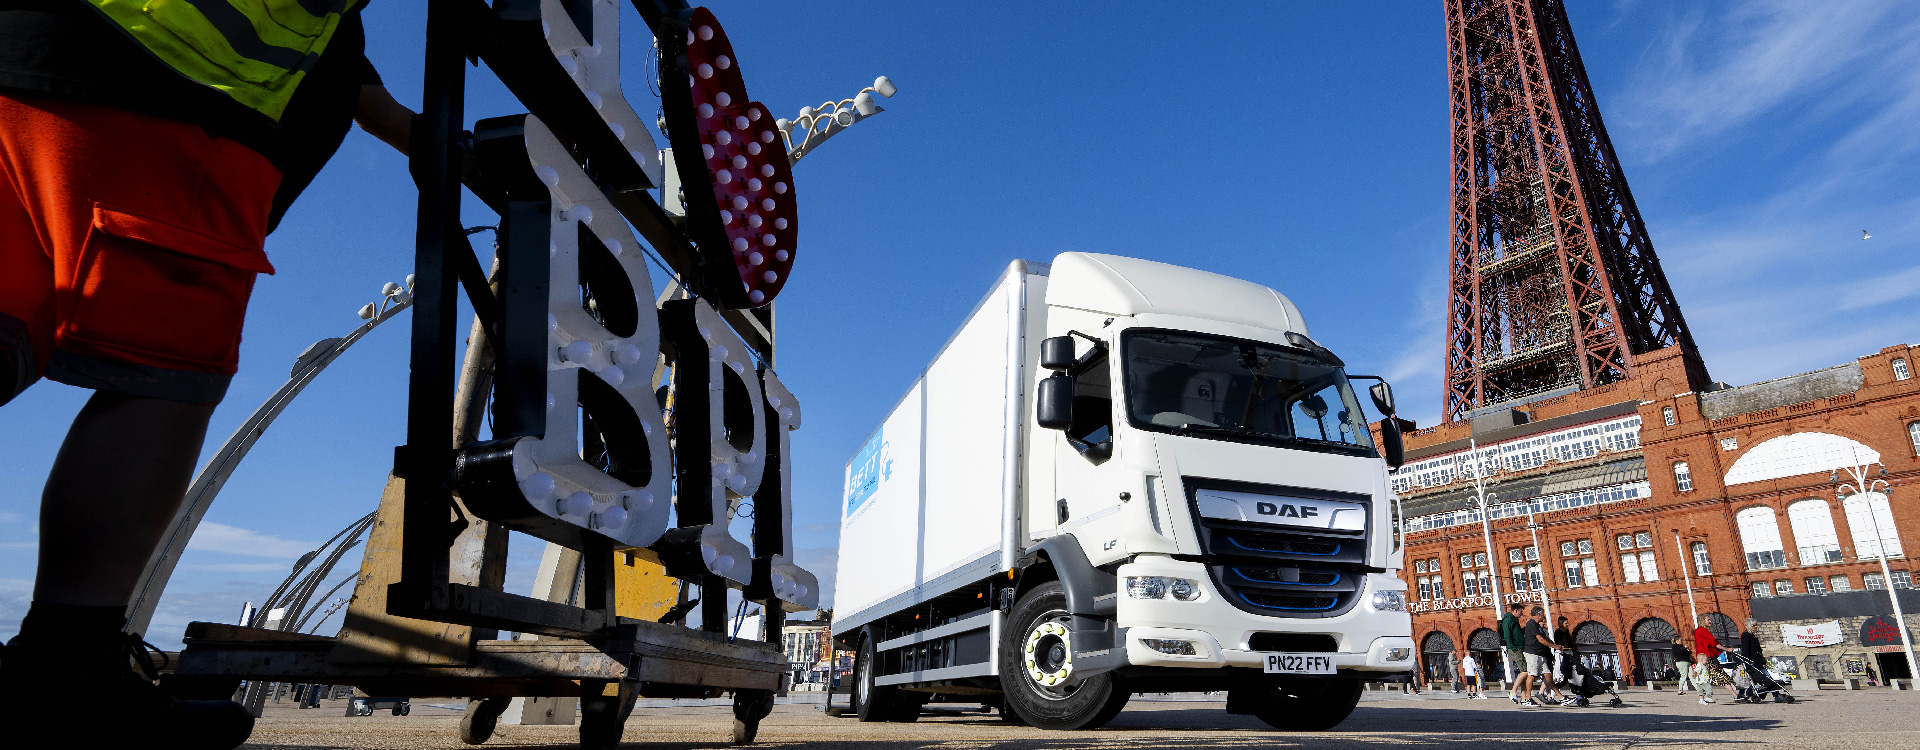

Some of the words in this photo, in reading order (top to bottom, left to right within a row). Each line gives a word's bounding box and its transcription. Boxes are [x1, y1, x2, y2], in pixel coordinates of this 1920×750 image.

[850, 451, 878, 495] BETT
[1256, 501, 1319, 519] DAF
[1103, 538, 1118, 551] LF
[1408, 601, 1431, 613] THE
[1433, 595, 1495, 611] BLACKPOO
[1268, 655, 1304, 671] PN22
[1306, 656, 1330, 671] FFV
